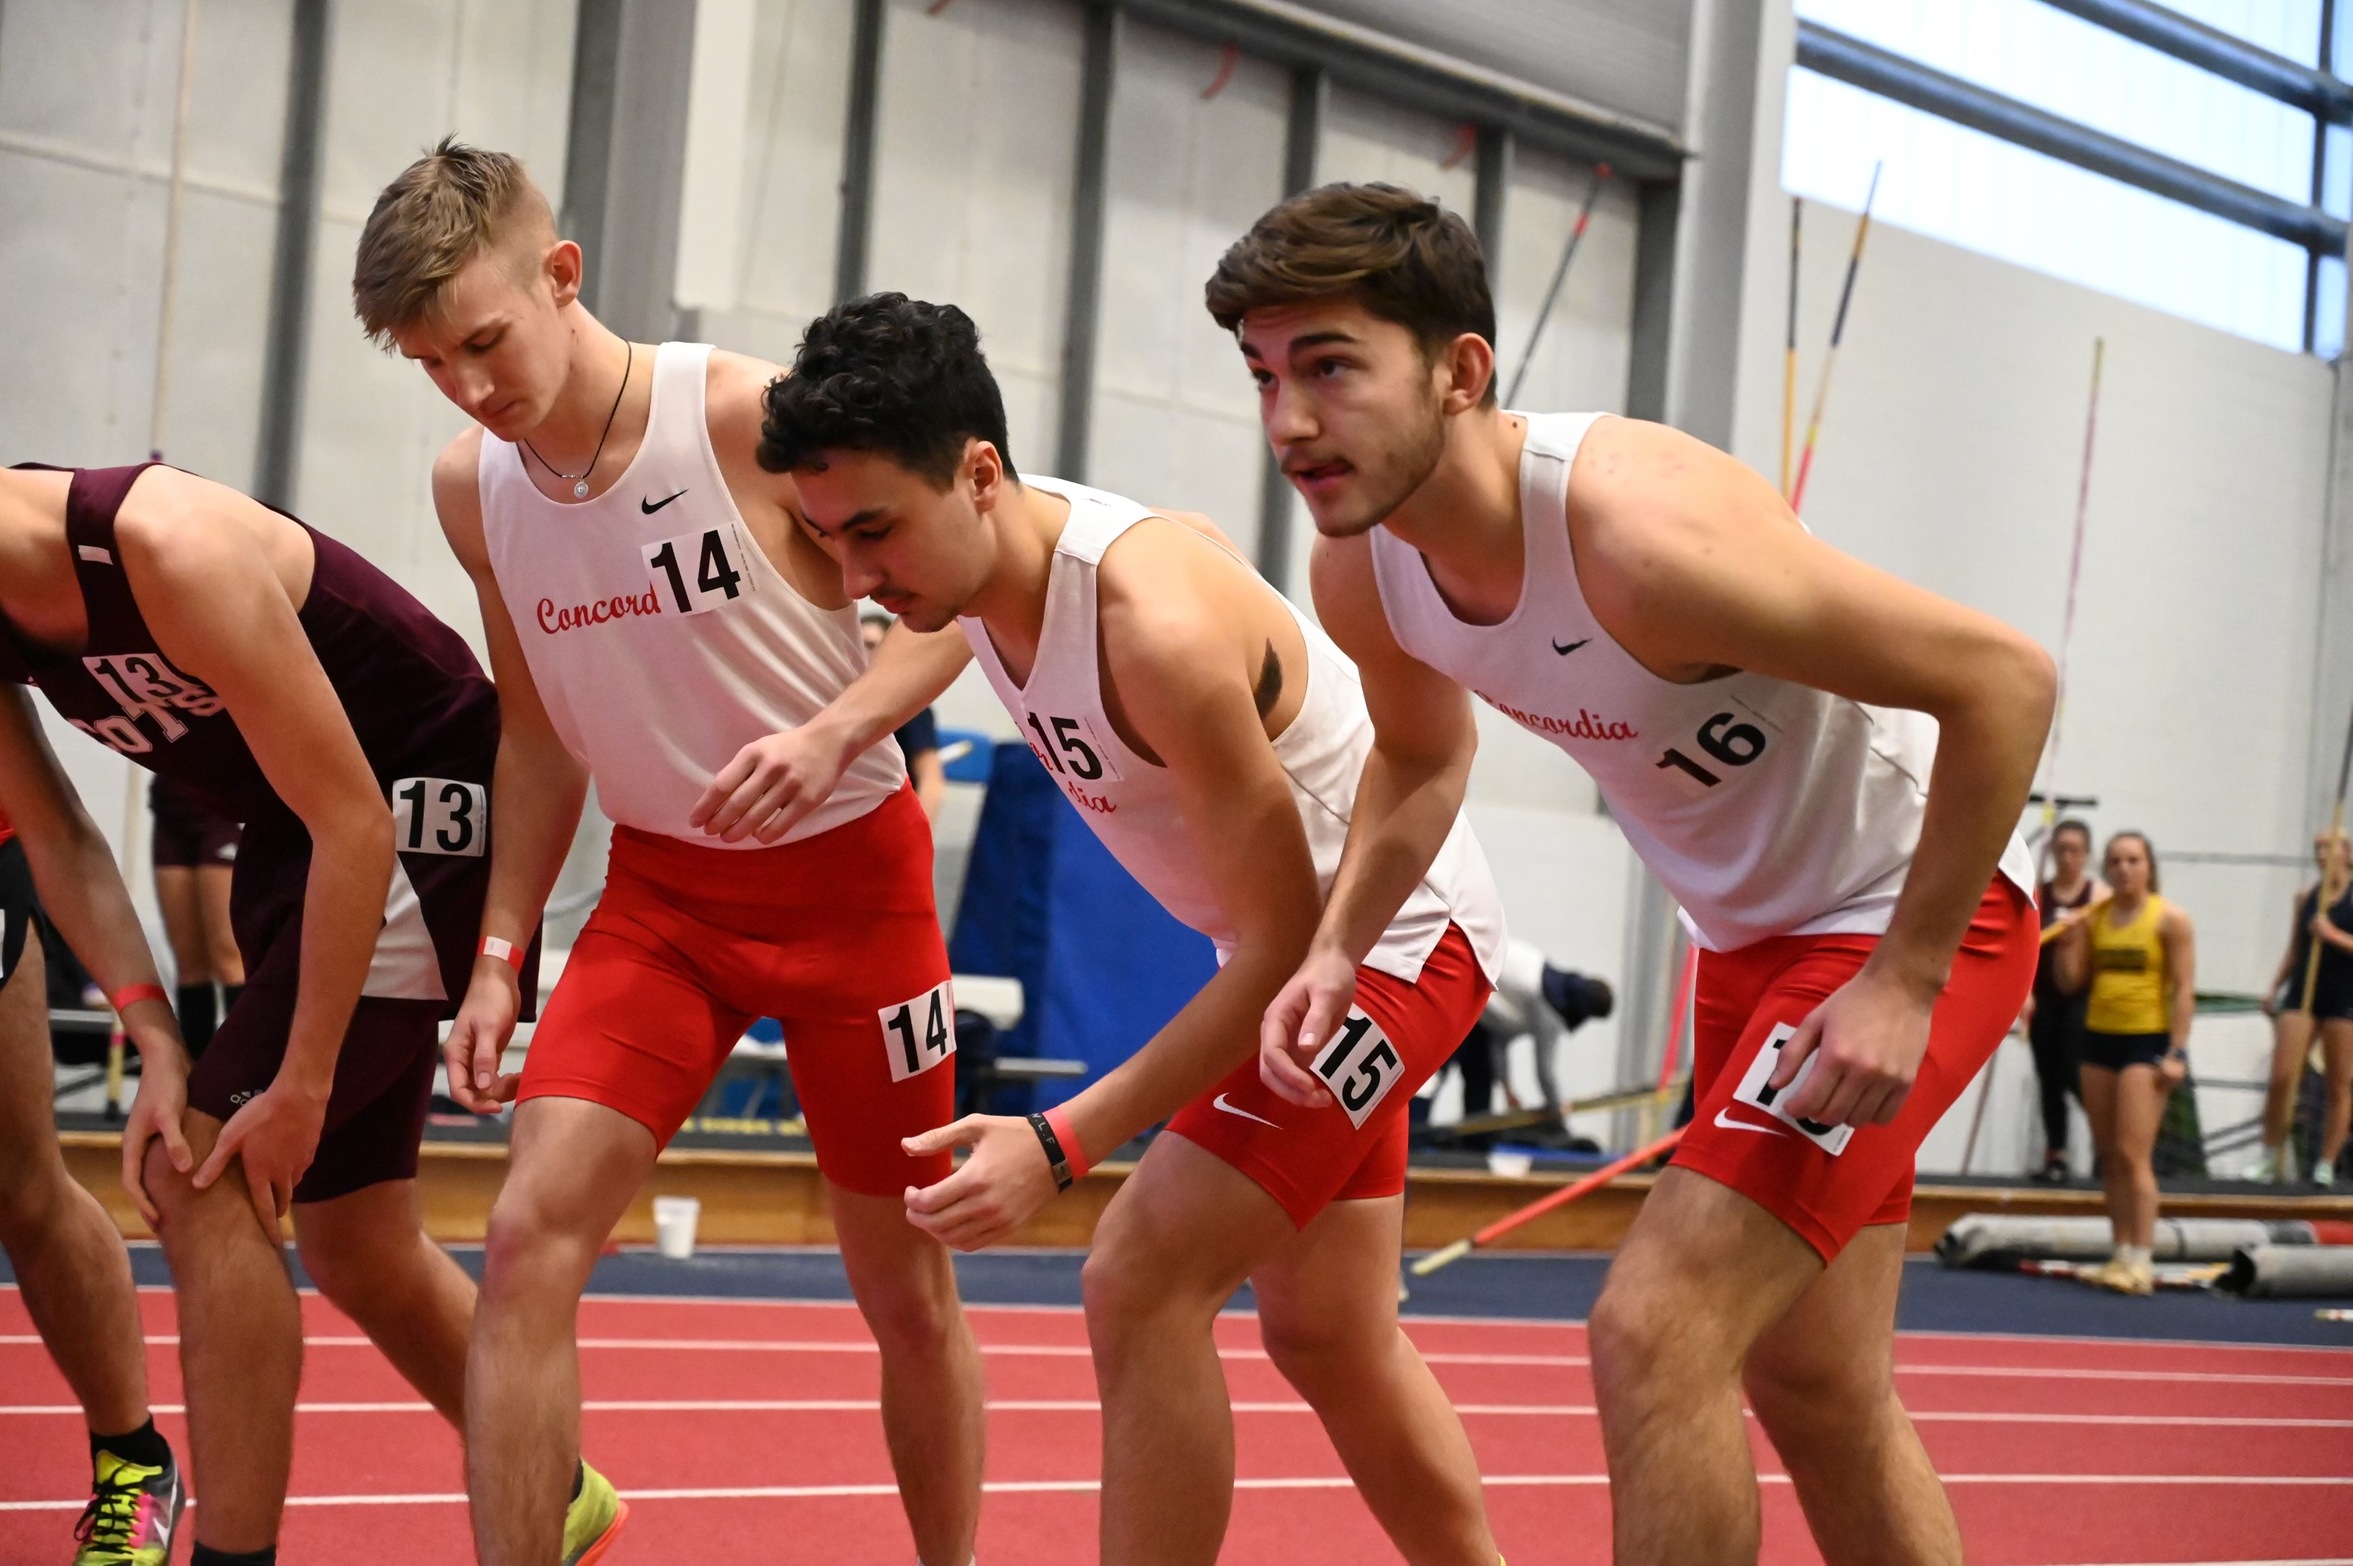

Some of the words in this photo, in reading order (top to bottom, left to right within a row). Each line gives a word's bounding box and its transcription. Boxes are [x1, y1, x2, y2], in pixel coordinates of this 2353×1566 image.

[536, 580, 661, 634] Concord
[650, 529, 741, 613] 14
[94, 656, 183, 703] 13
[1474, 690, 1638, 740] oncordia
[1027, 711, 1103, 780] 15
[1655, 712, 1766, 787] 16
[400, 780, 472, 852] 13
[888, 989, 948, 1073] 14
[1319, 1016, 1398, 1112] 15
